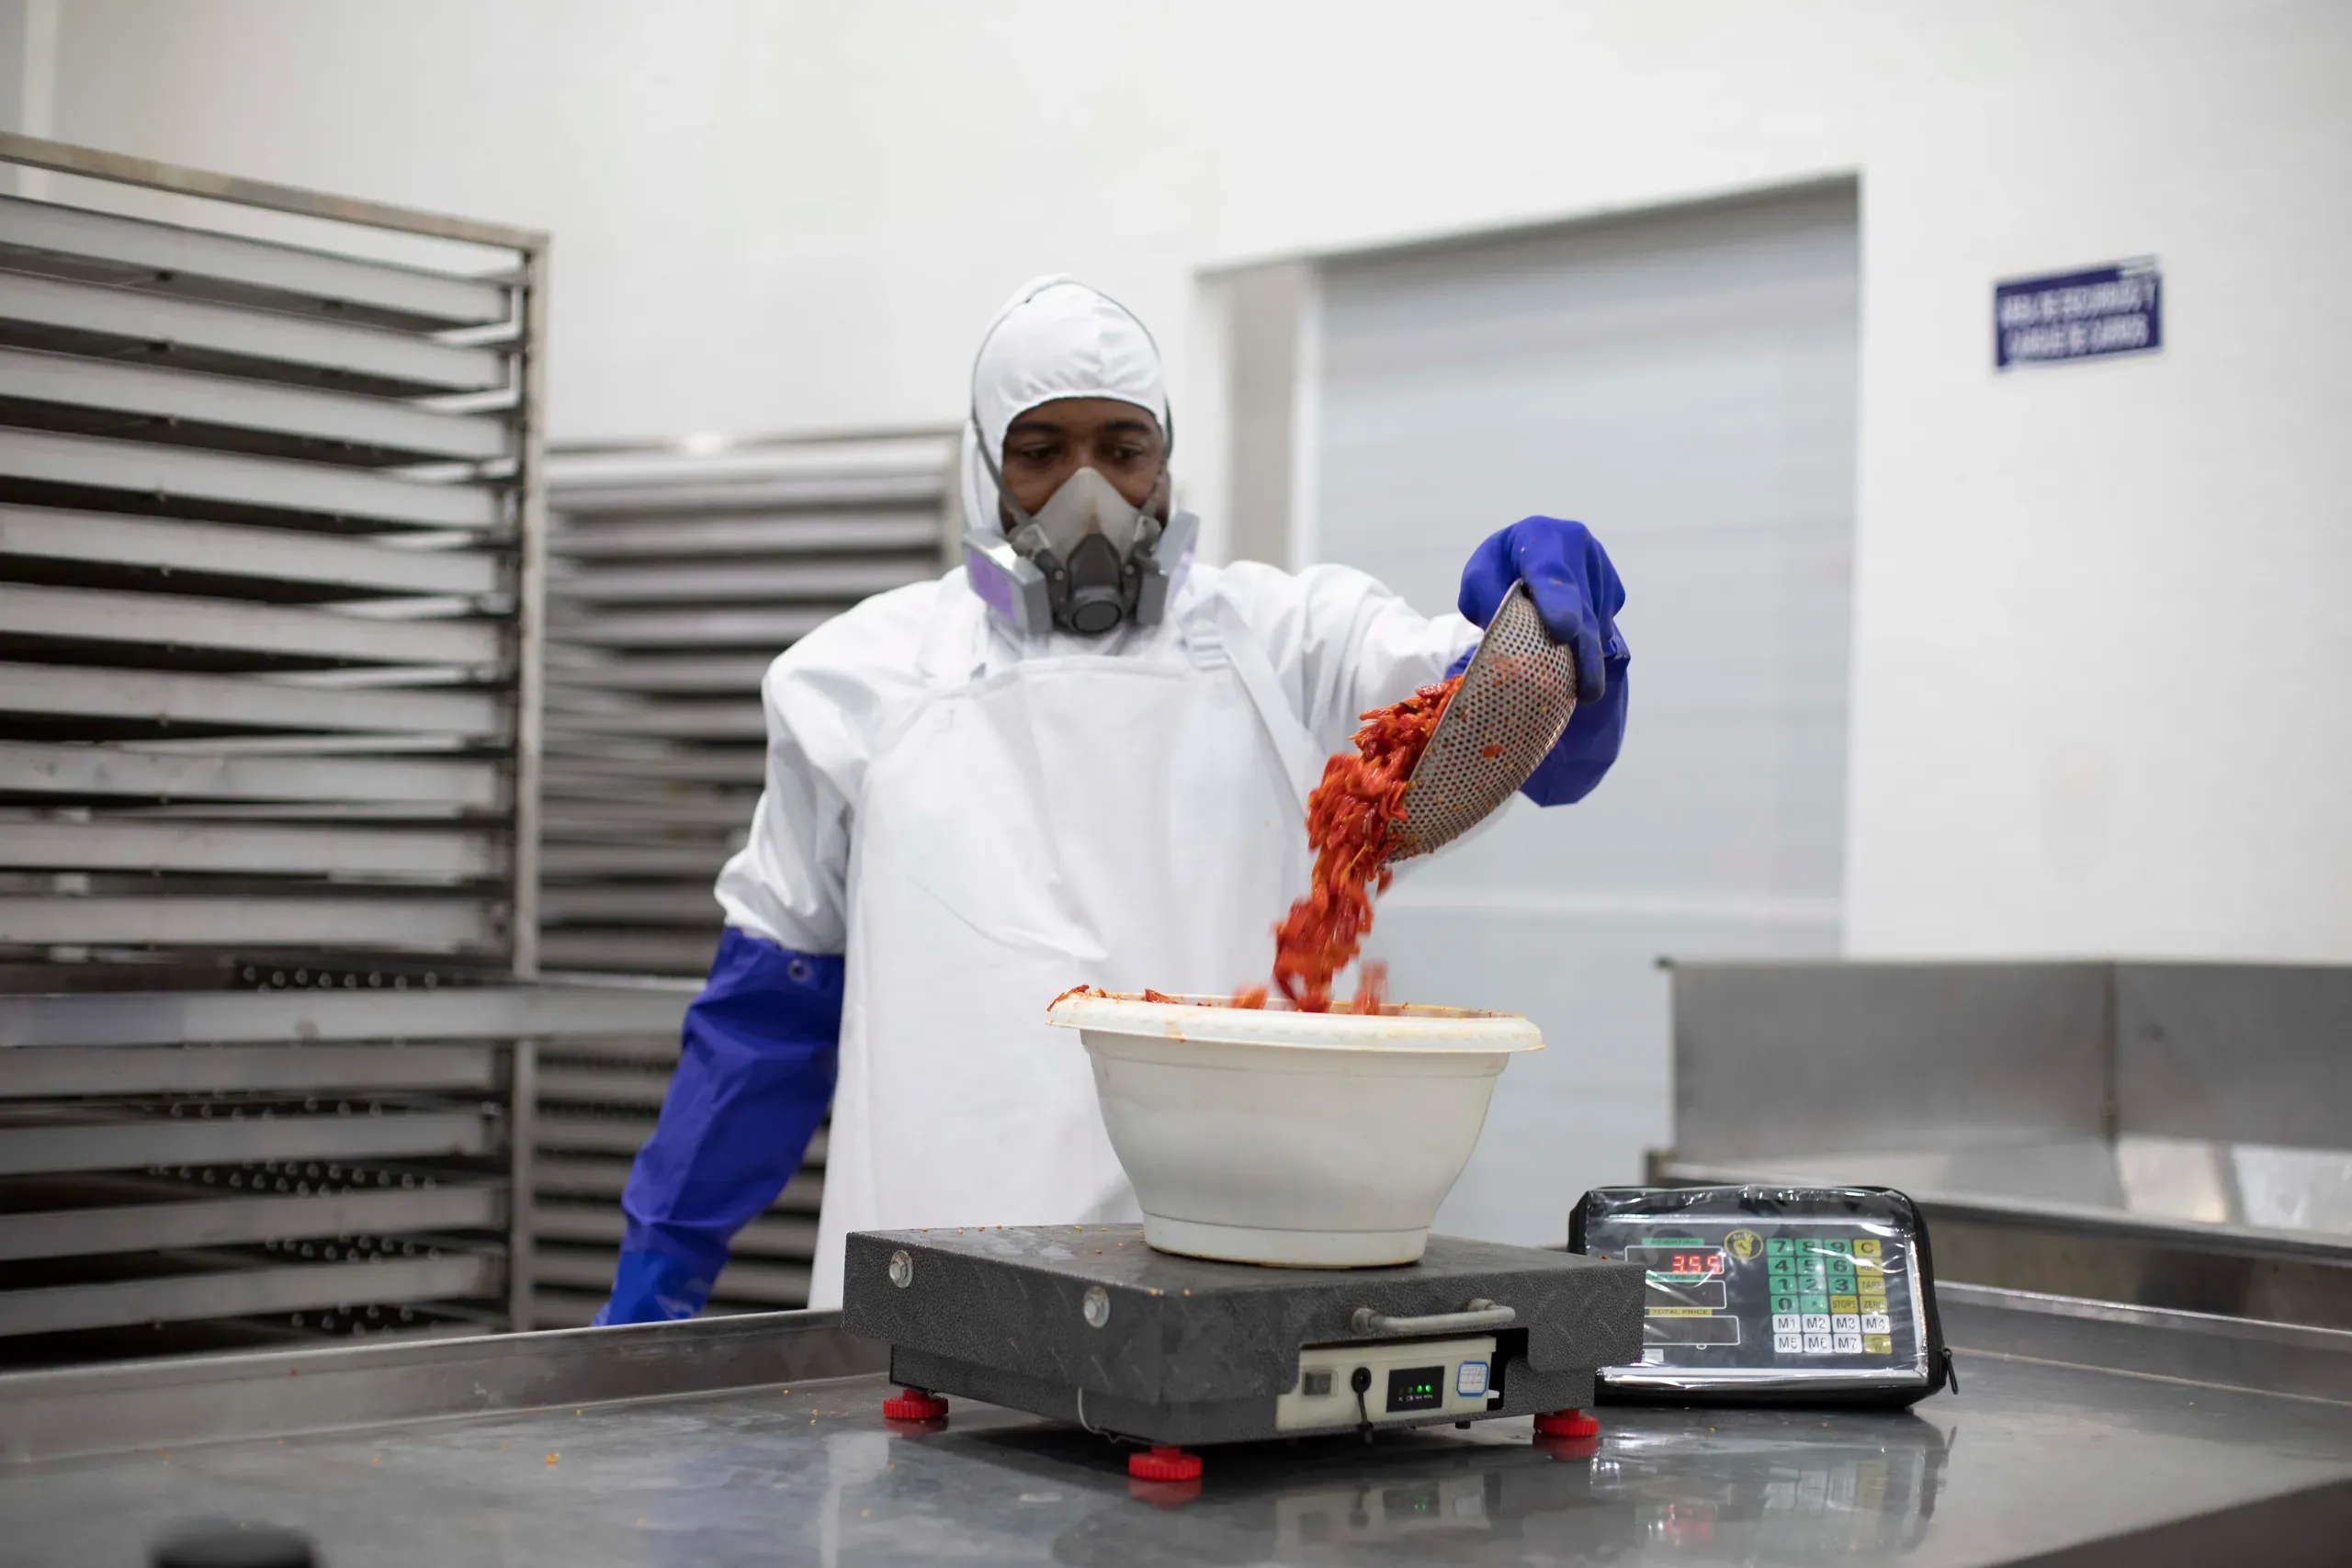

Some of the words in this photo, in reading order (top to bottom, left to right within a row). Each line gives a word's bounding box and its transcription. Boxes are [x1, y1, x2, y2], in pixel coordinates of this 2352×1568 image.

[1773, 1240, 1786, 1253] 7
[1803, 1241, 1815, 1253] 8
[1830, 1242, 1845, 1255] 9
[1860, 1242, 1874, 1254] C
[1774, 1259, 1789, 1272] 4
[1804, 1259, 1815, 1272] 5
[1833, 1259, 1848, 1272] 6
[1778, 1279, 1788, 1292] 1
[1805, 1278, 1819, 1292] 2
[1834, 1279, 1849, 1292] 3
[1778, 1297, 1792, 1312] 0
[1832, 1300, 1856, 1309] STORE
[1778, 1318, 1795, 1330] M1
[1807, 1318, 1826, 1329] M2
[1837, 1318, 1856, 1329] M3
[1866, 1318, 1885, 1330] M4
[1779, 1337, 1798, 1349] M5
[1808, 1337, 1826, 1349] M6
[1838, 1337, 1857, 1349] M7
